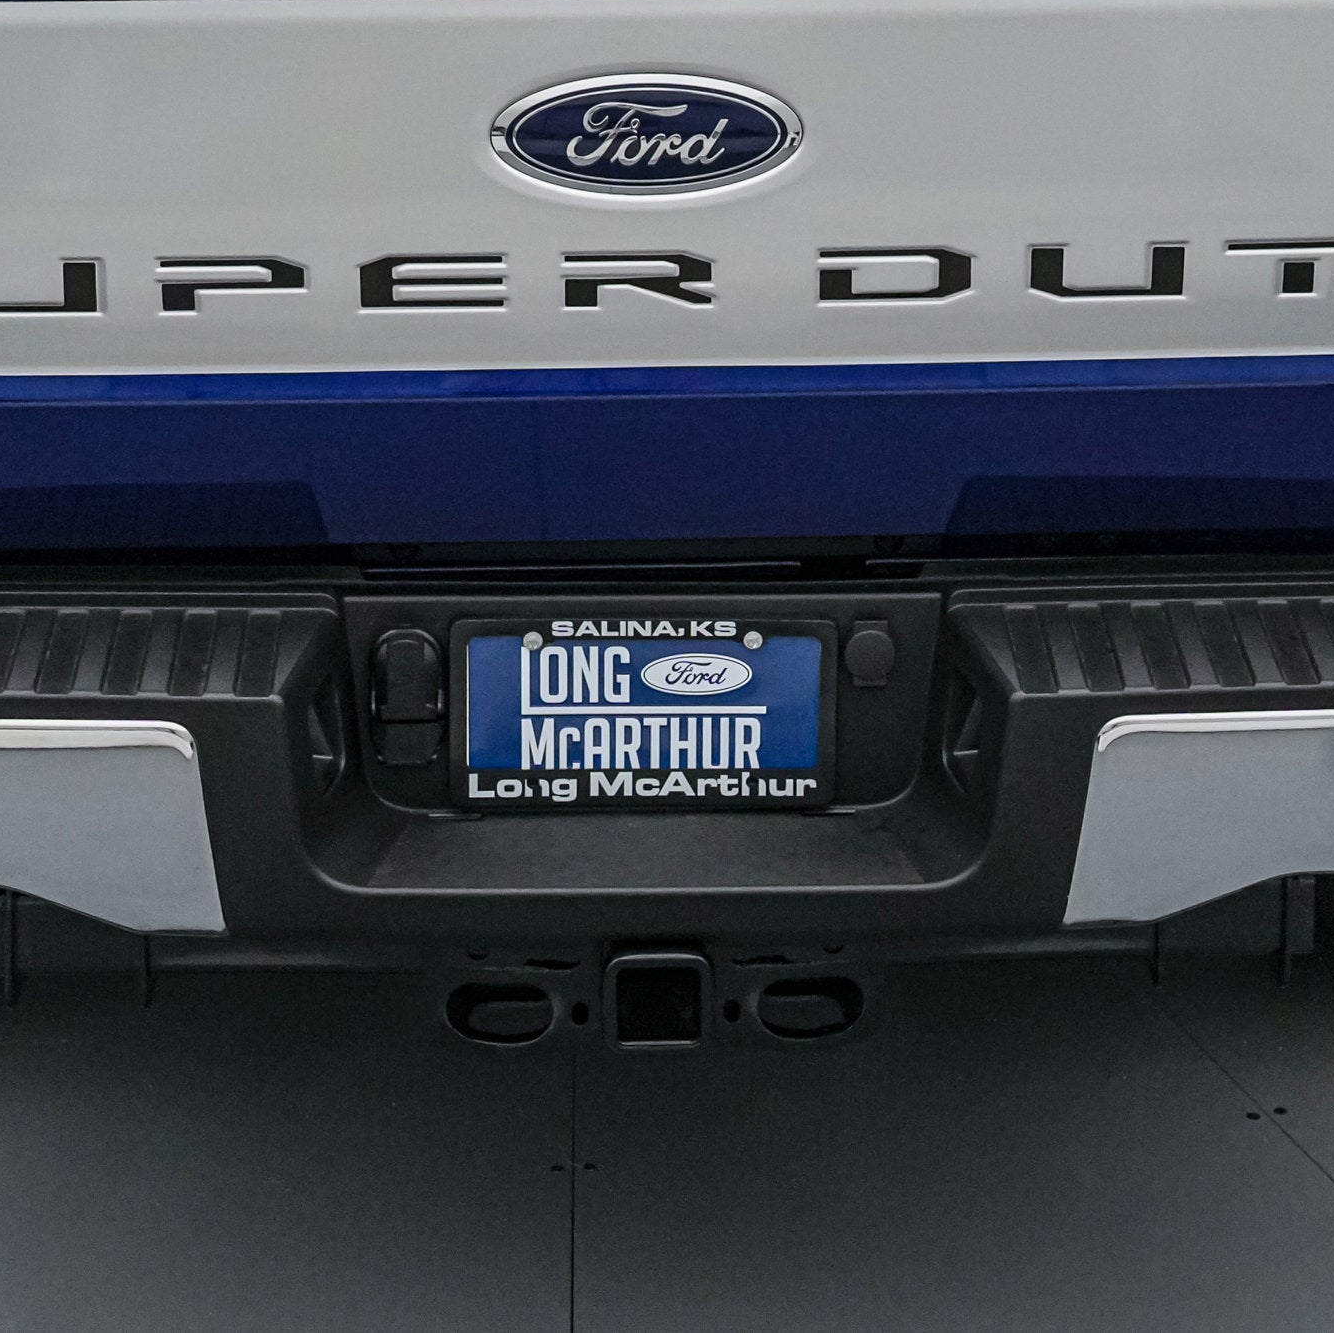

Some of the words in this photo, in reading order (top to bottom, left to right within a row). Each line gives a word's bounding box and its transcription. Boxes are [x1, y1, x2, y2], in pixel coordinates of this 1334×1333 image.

[567, 101, 729, 166] Ford
[551, 620, 685, 637] SALINA,
[690, 620, 737, 636] KS
[521, 645, 631, 714] LONG
[665, 660, 727, 686] Ford
[521, 717, 762, 770] McARTHUR
[468, 773, 578, 802] Long
[589, 772, 818, 798] McArthur
